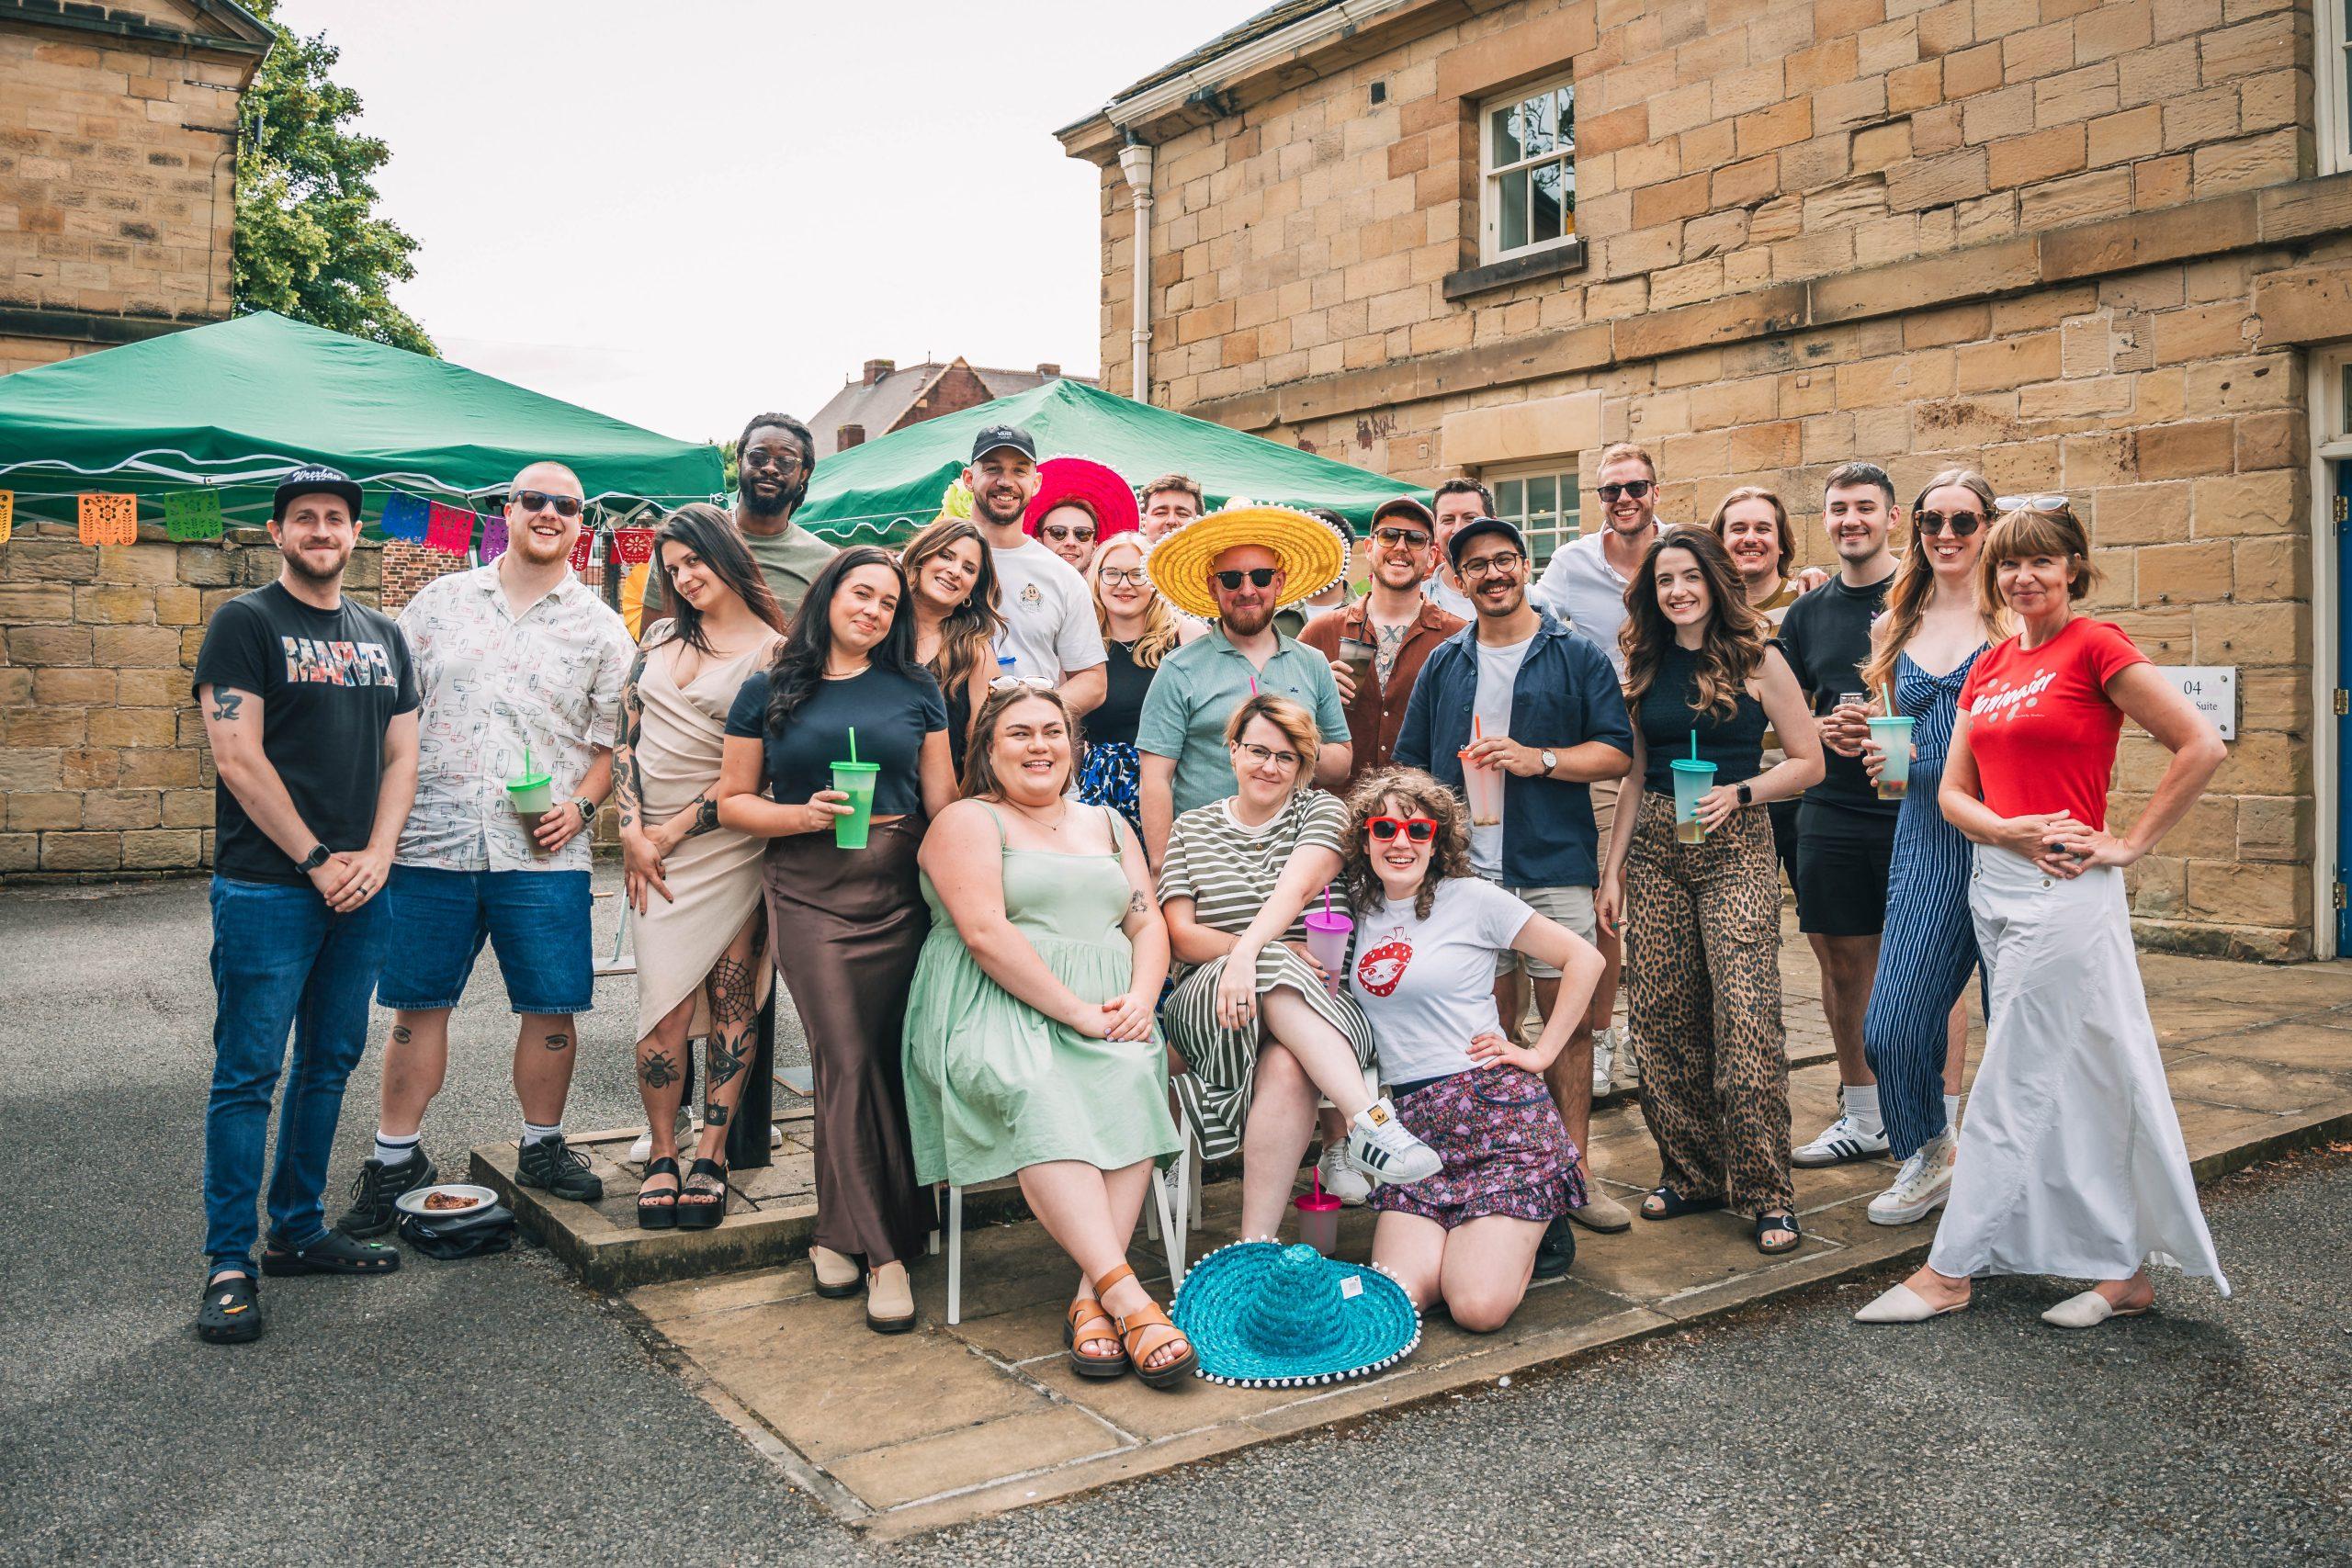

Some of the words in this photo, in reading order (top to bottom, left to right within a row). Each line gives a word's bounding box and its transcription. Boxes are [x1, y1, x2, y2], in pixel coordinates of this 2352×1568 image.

[292, 468, 342, 482] Wrexham
[281, 636, 398, 687] MARVEL
[2183, 680, 2202, 695] 04
[2196, 701, 2218, 711] Suite
